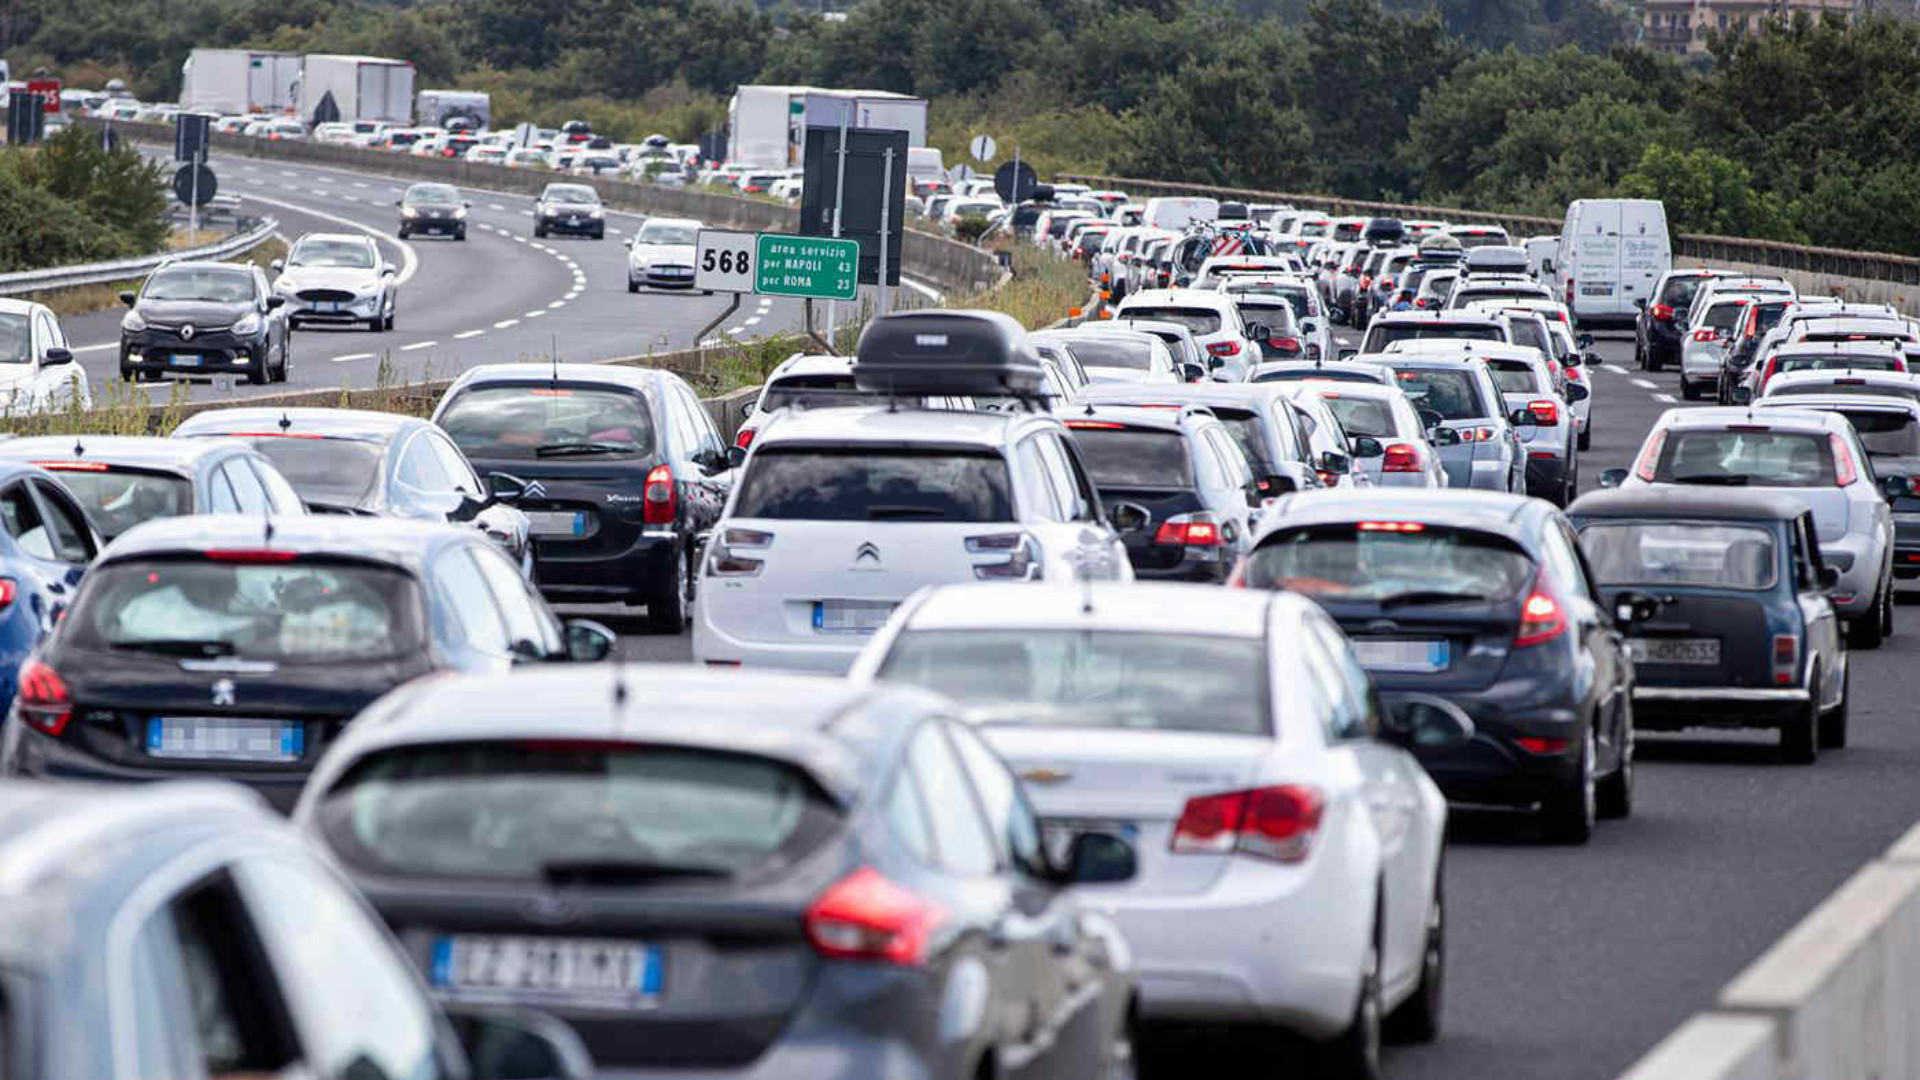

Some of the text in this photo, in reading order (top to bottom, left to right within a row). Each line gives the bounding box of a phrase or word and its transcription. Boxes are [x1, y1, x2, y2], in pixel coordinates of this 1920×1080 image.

[770, 245, 846, 258] area servizio
[701, 249, 750, 274] 568
[763, 259, 851, 273] per NAPOLI 43
[762, 275, 850, 290] per ROMA 23
